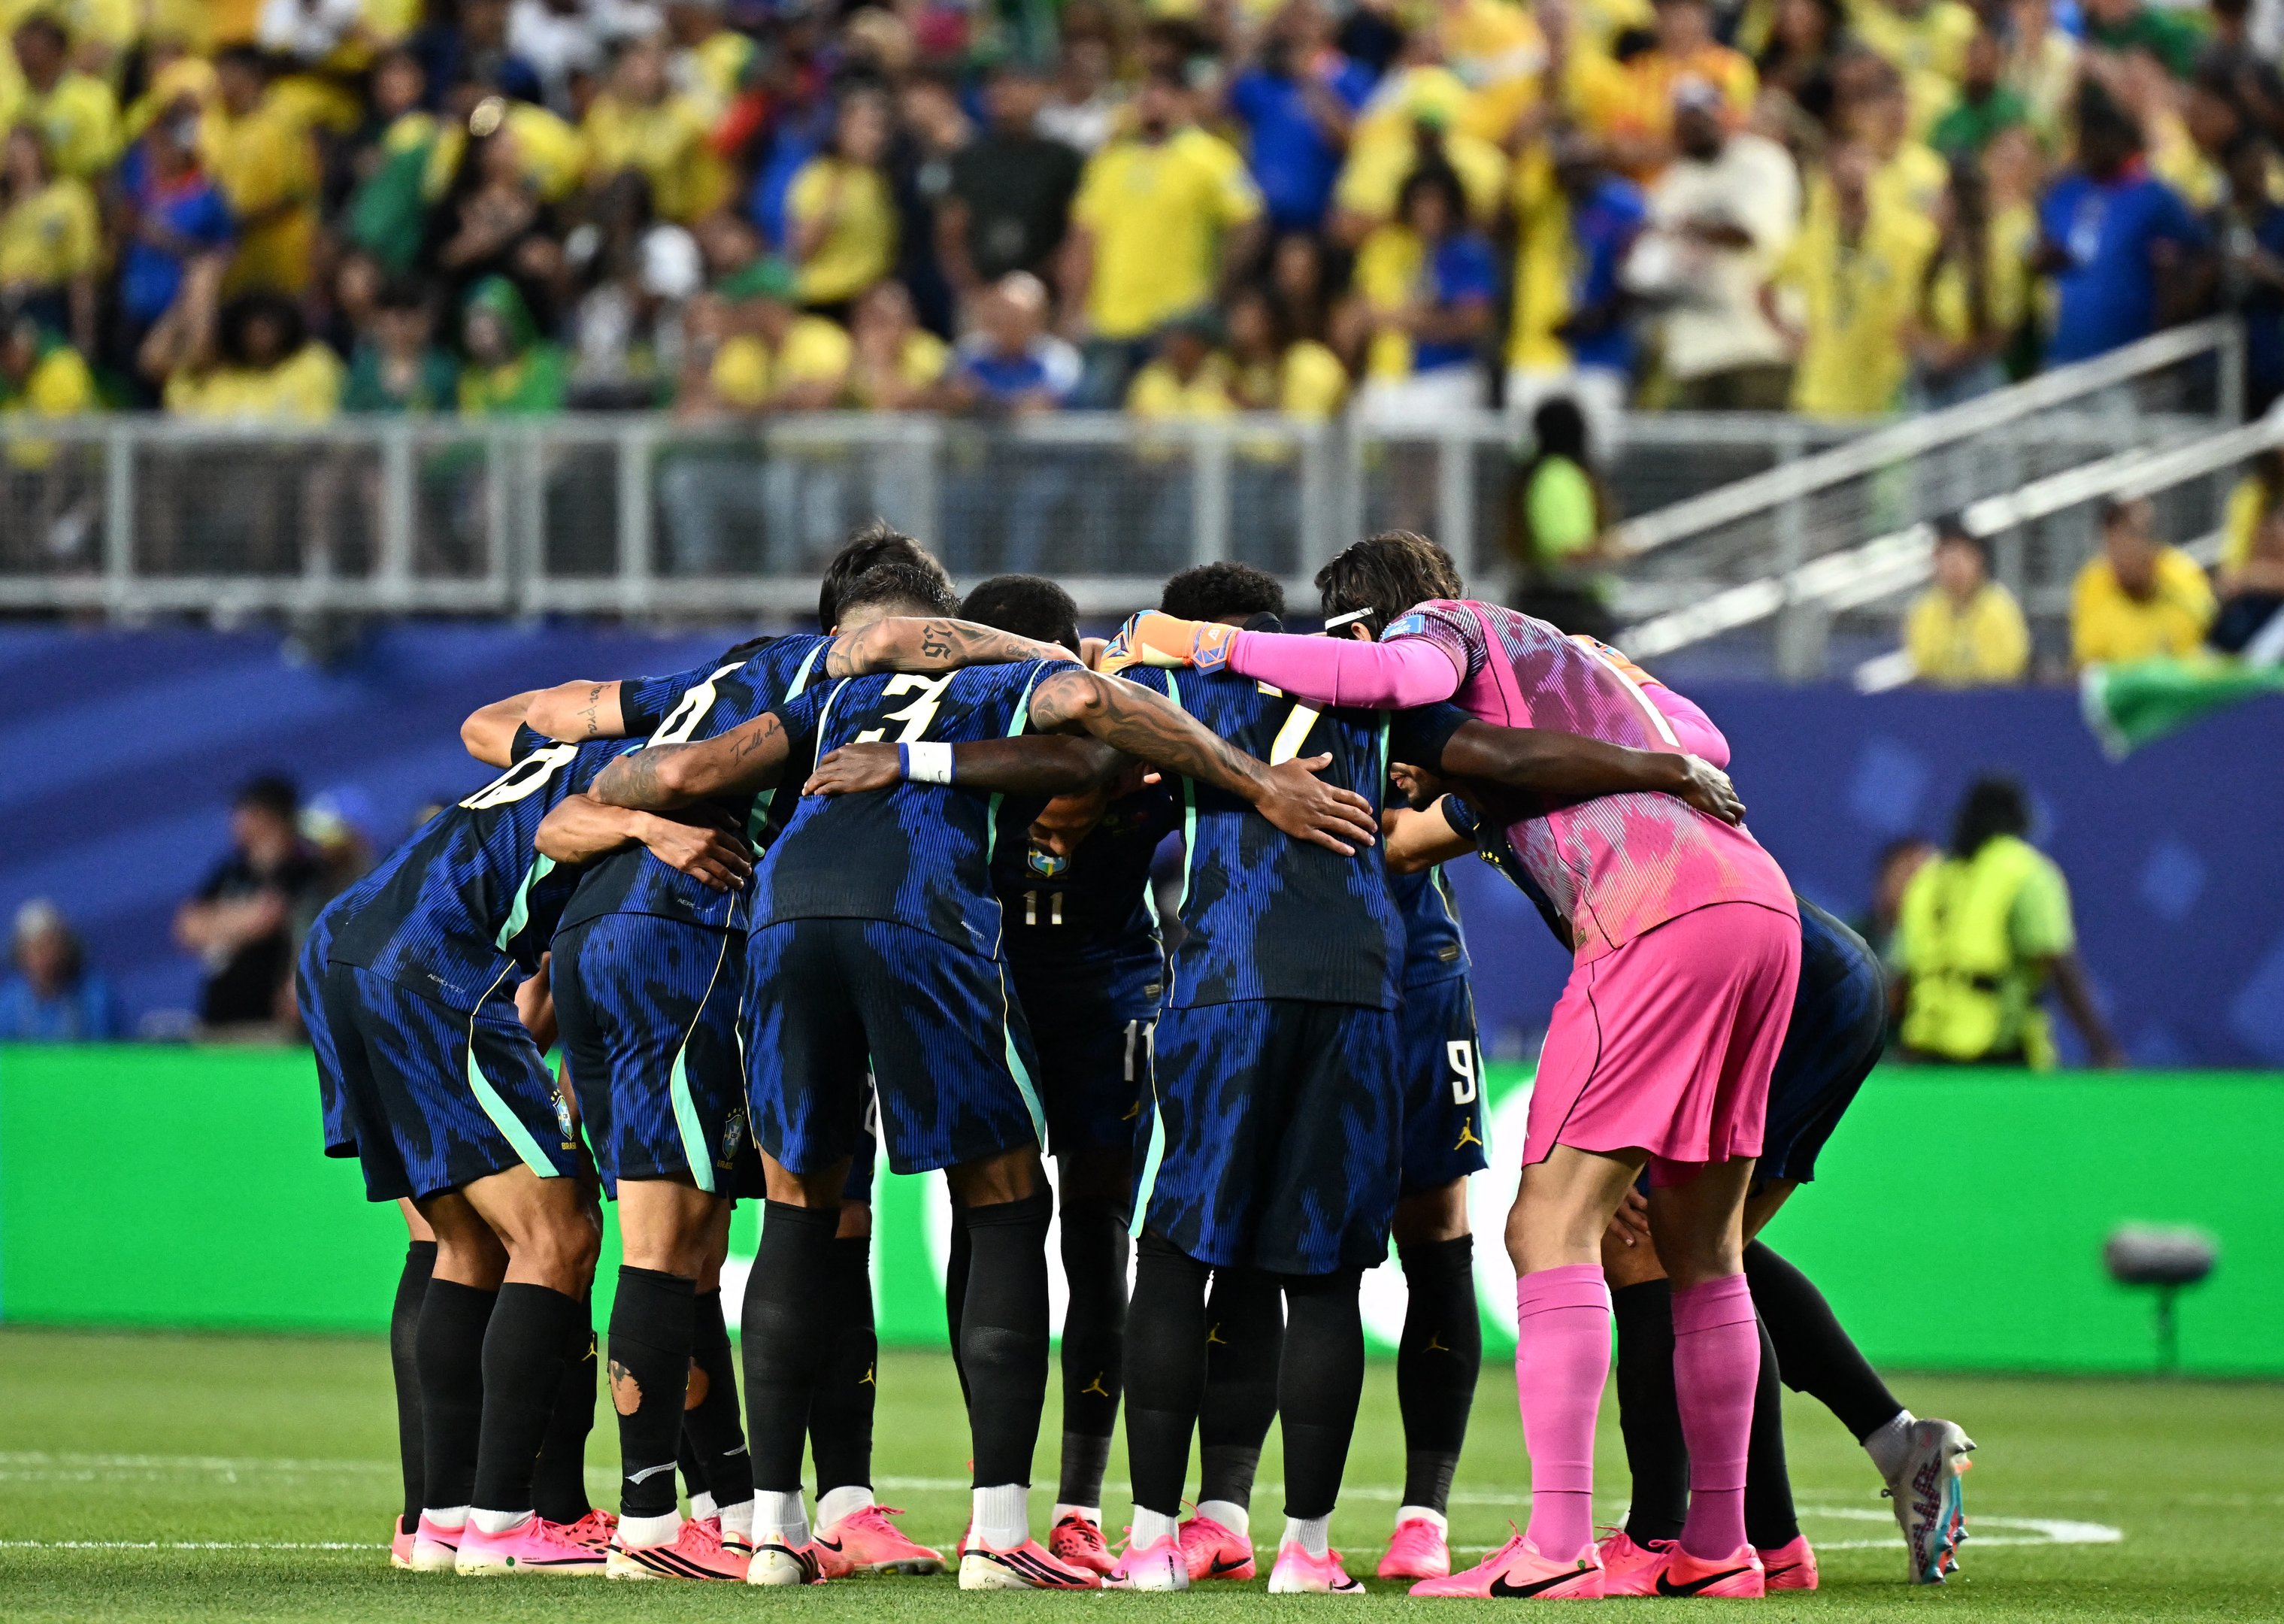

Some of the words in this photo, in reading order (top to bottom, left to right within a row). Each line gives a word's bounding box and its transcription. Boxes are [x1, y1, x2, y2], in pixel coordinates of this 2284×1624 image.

[853, 668, 961, 744] 3
[1022, 890, 1062, 925] 11
[1446, 1040, 1477, 1105] 9
